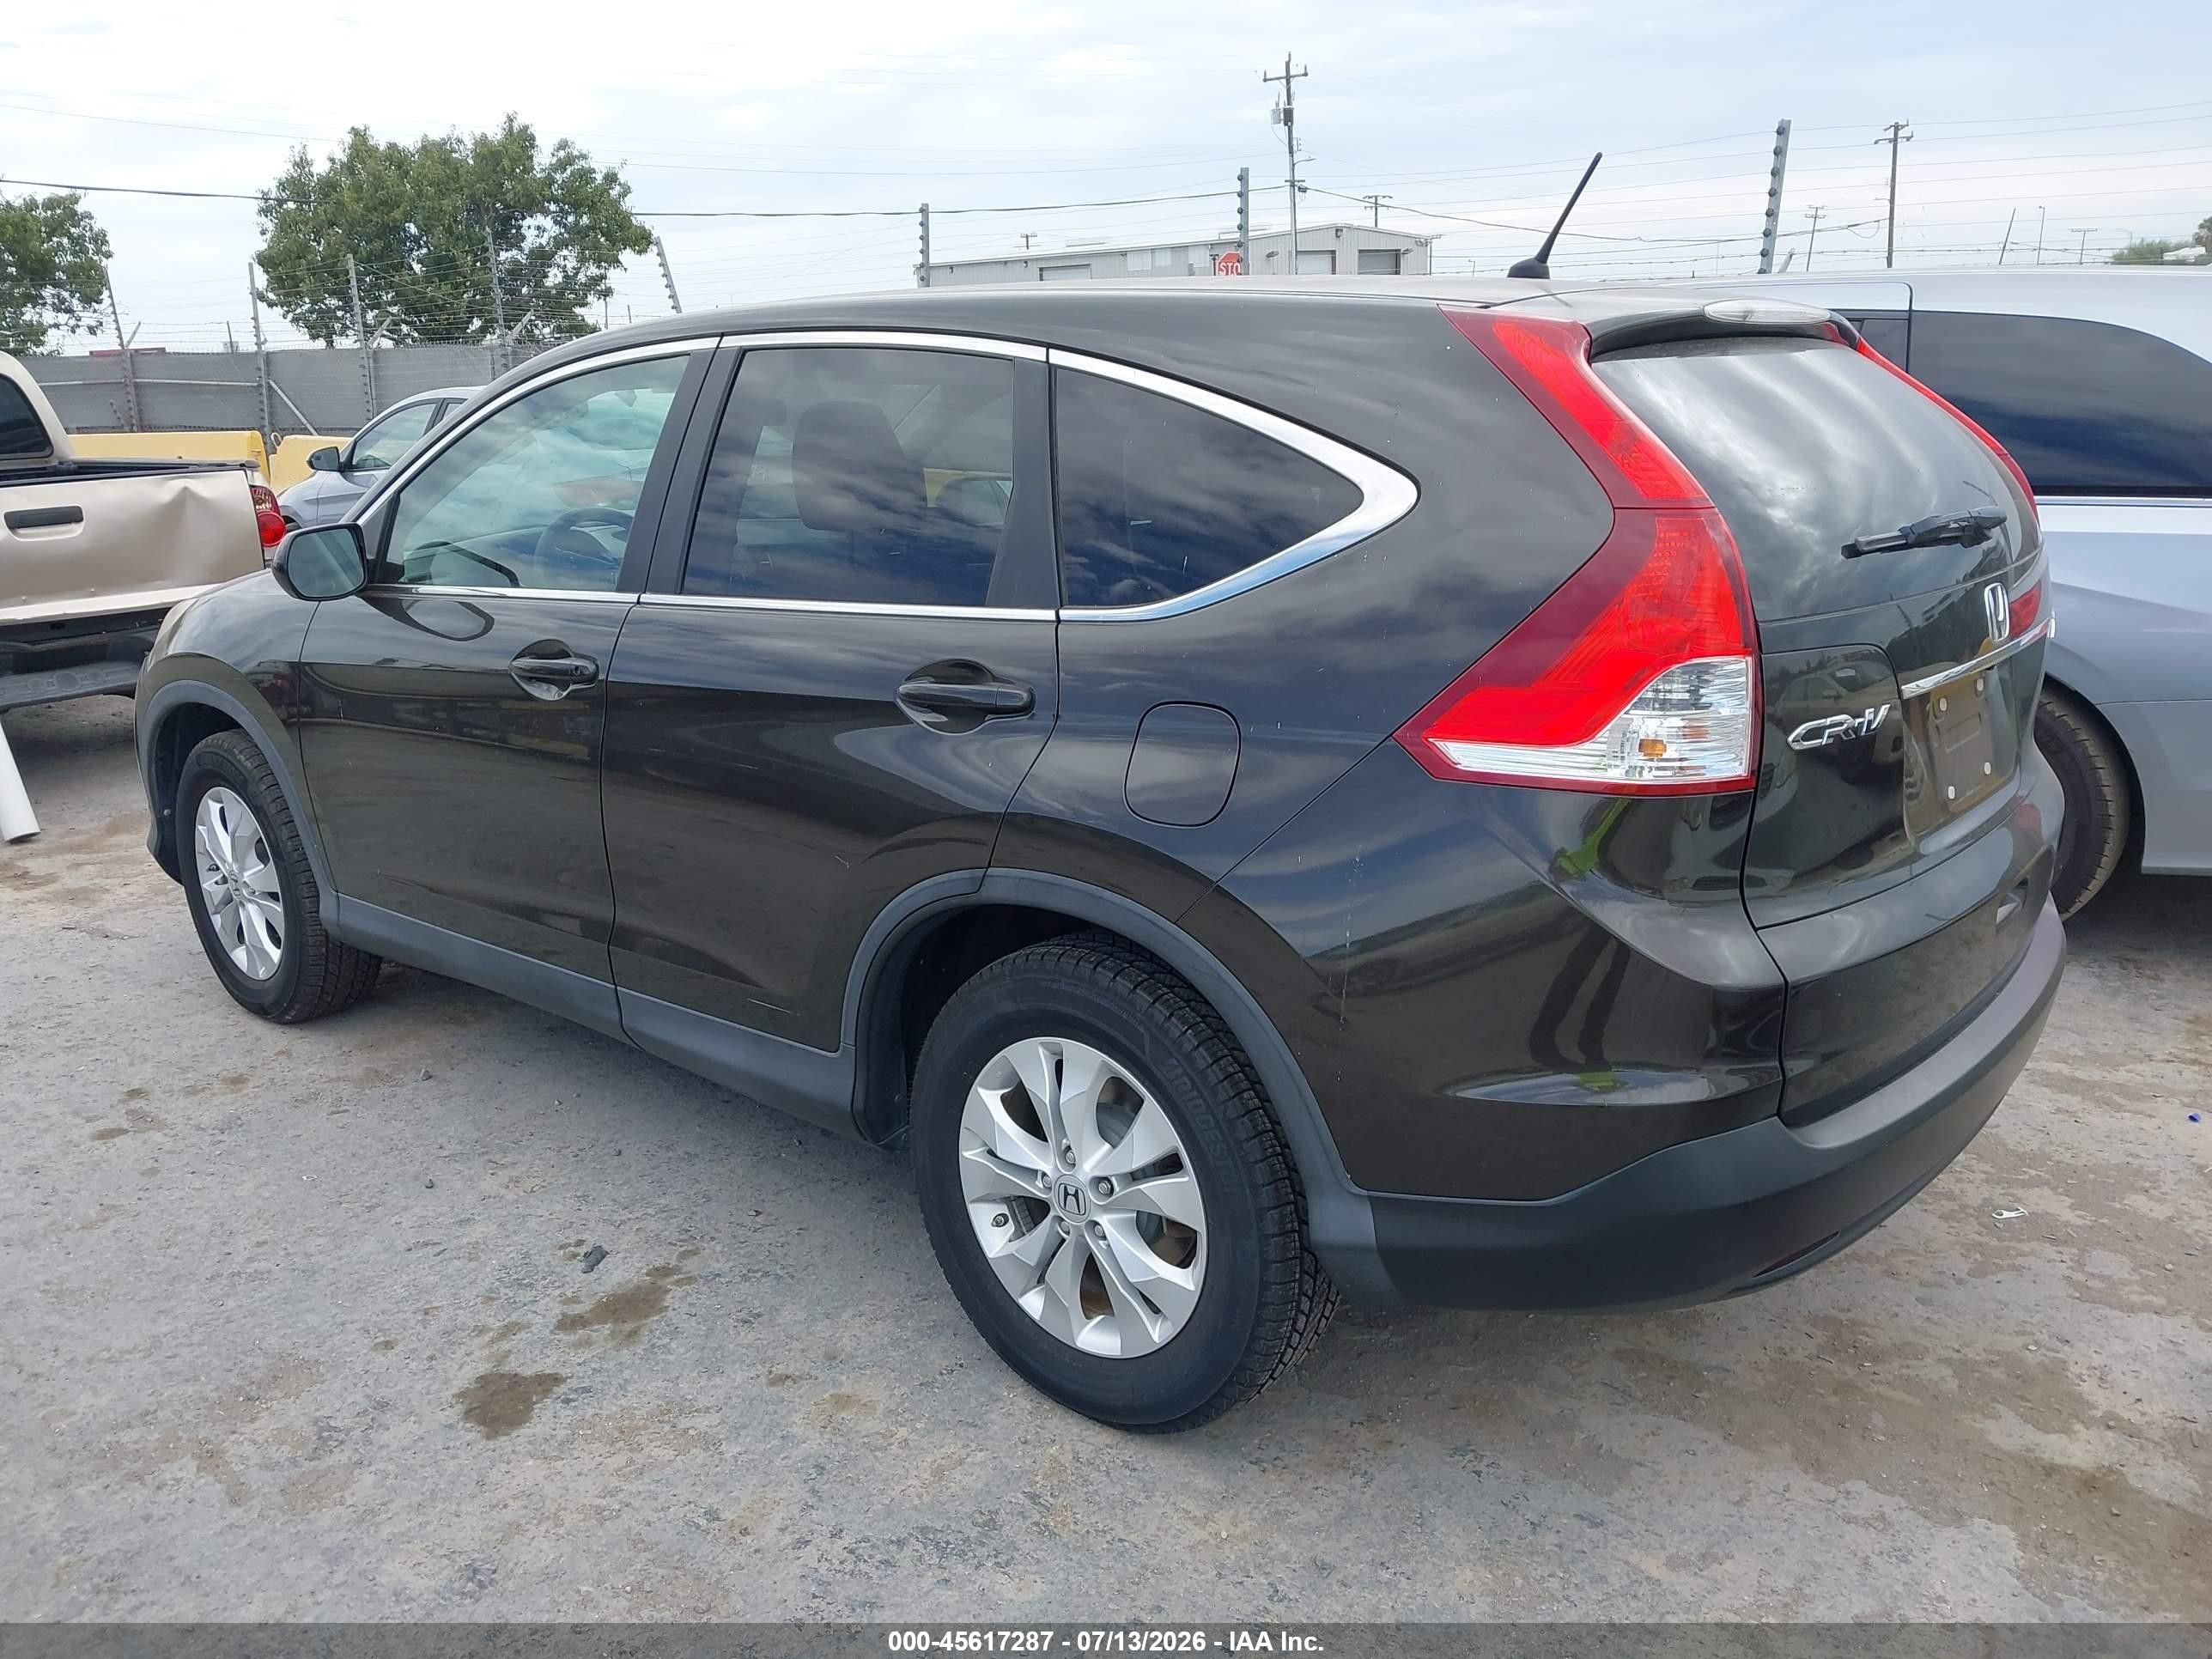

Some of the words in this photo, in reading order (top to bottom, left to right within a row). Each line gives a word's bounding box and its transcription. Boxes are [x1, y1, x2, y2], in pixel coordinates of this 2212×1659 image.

[1220, 263, 1241, 276] STO
[1788, 704, 1890, 750] CR-V
[1159, 1056, 1240, 1204] BRIDGESTO
